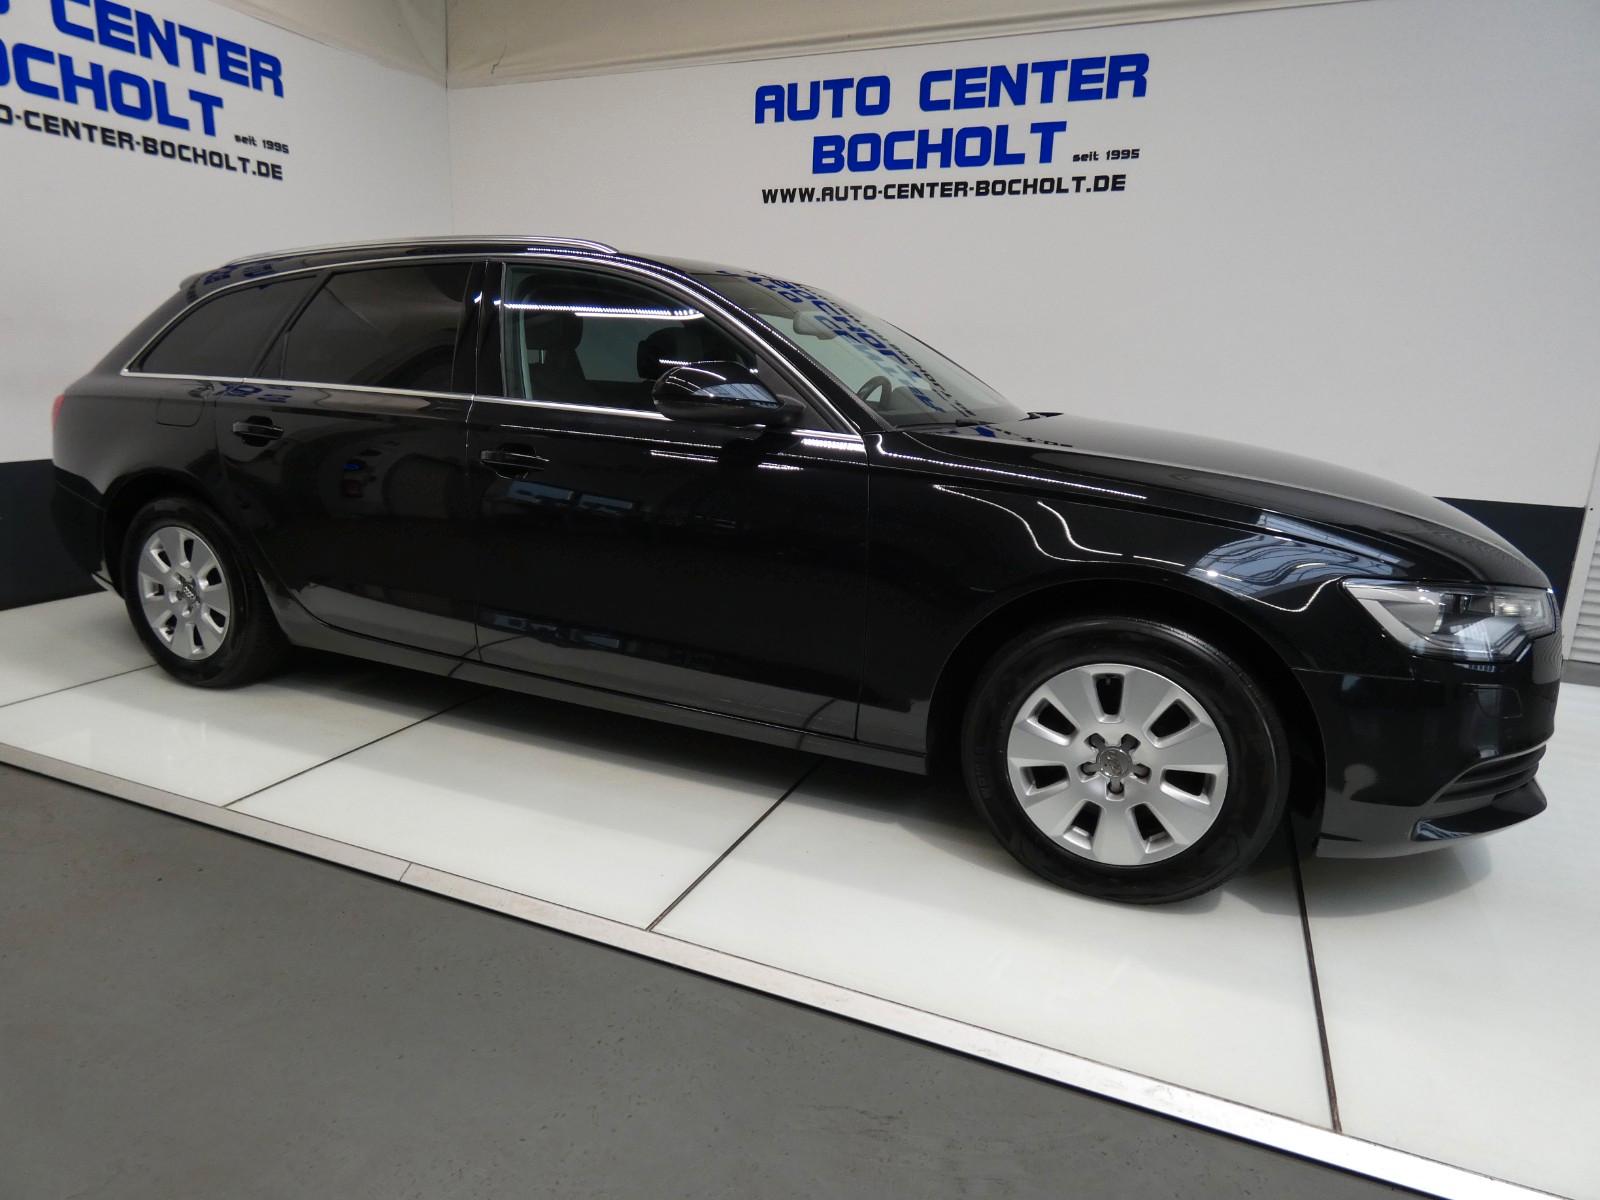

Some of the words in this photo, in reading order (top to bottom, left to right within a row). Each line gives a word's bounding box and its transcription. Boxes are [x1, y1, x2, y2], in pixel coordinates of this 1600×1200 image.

[51, 0, 285, 98] CENTER
[0, 39, 224, 137] CHOLT
[755, 75, 891, 124] AUTO
[919, 53, 1150, 112] CENTER
[234, 133, 258, 147] seit
[262, 139, 290, 154] 1995
[812, 121, 1067, 174] BOCHOLT
[1072, 151, 1100, 163] seit
[1105, 148, 1140, 161] 1995
[762, 174, 1127, 204] WWW.AUTO-CENTER-BOCHOLT.DE
